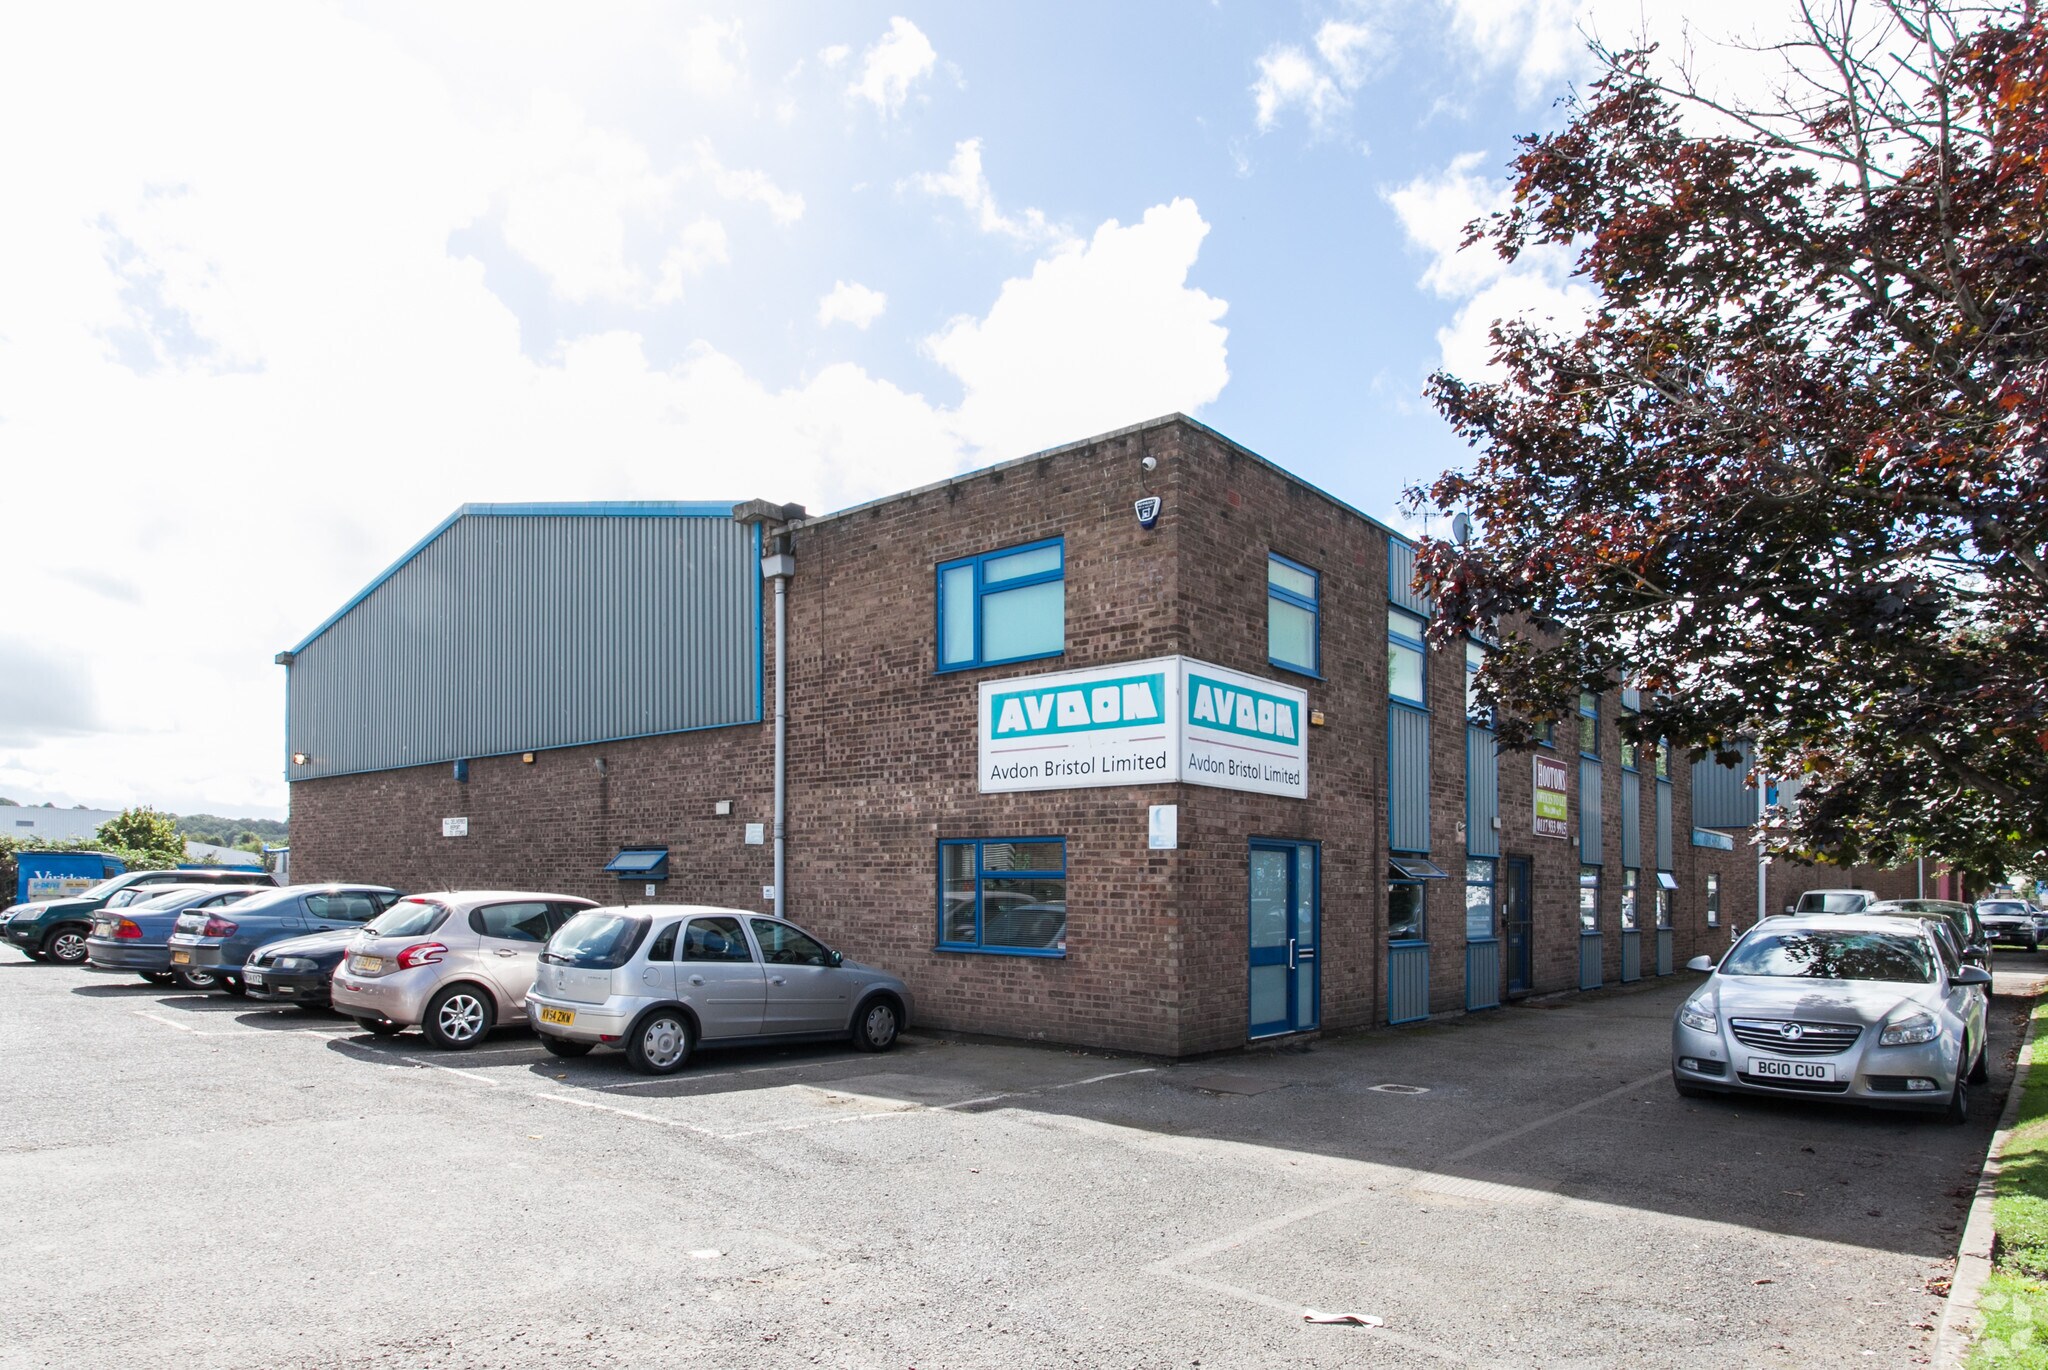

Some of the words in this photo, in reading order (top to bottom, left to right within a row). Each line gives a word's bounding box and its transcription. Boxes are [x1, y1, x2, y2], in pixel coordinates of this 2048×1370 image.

[997, 682, 1158, 733] AVDON
[1193, 684, 1295, 739] AVDON
[990, 763, 1038, 780] Avdon
[1045, 756, 1095, 777] Bristol
[1102, 751, 1166, 772] Limited
[1188, 753, 1225, 774] Avdon
[1228, 756, 1261, 779] Bristol
[1264, 764, 1300, 786] Limited
[1538, 764, 1566, 791] HOOTONS
[1758, 1061, 1791, 1076] BG10
[1795, 1064, 1825, 1078] CUO
